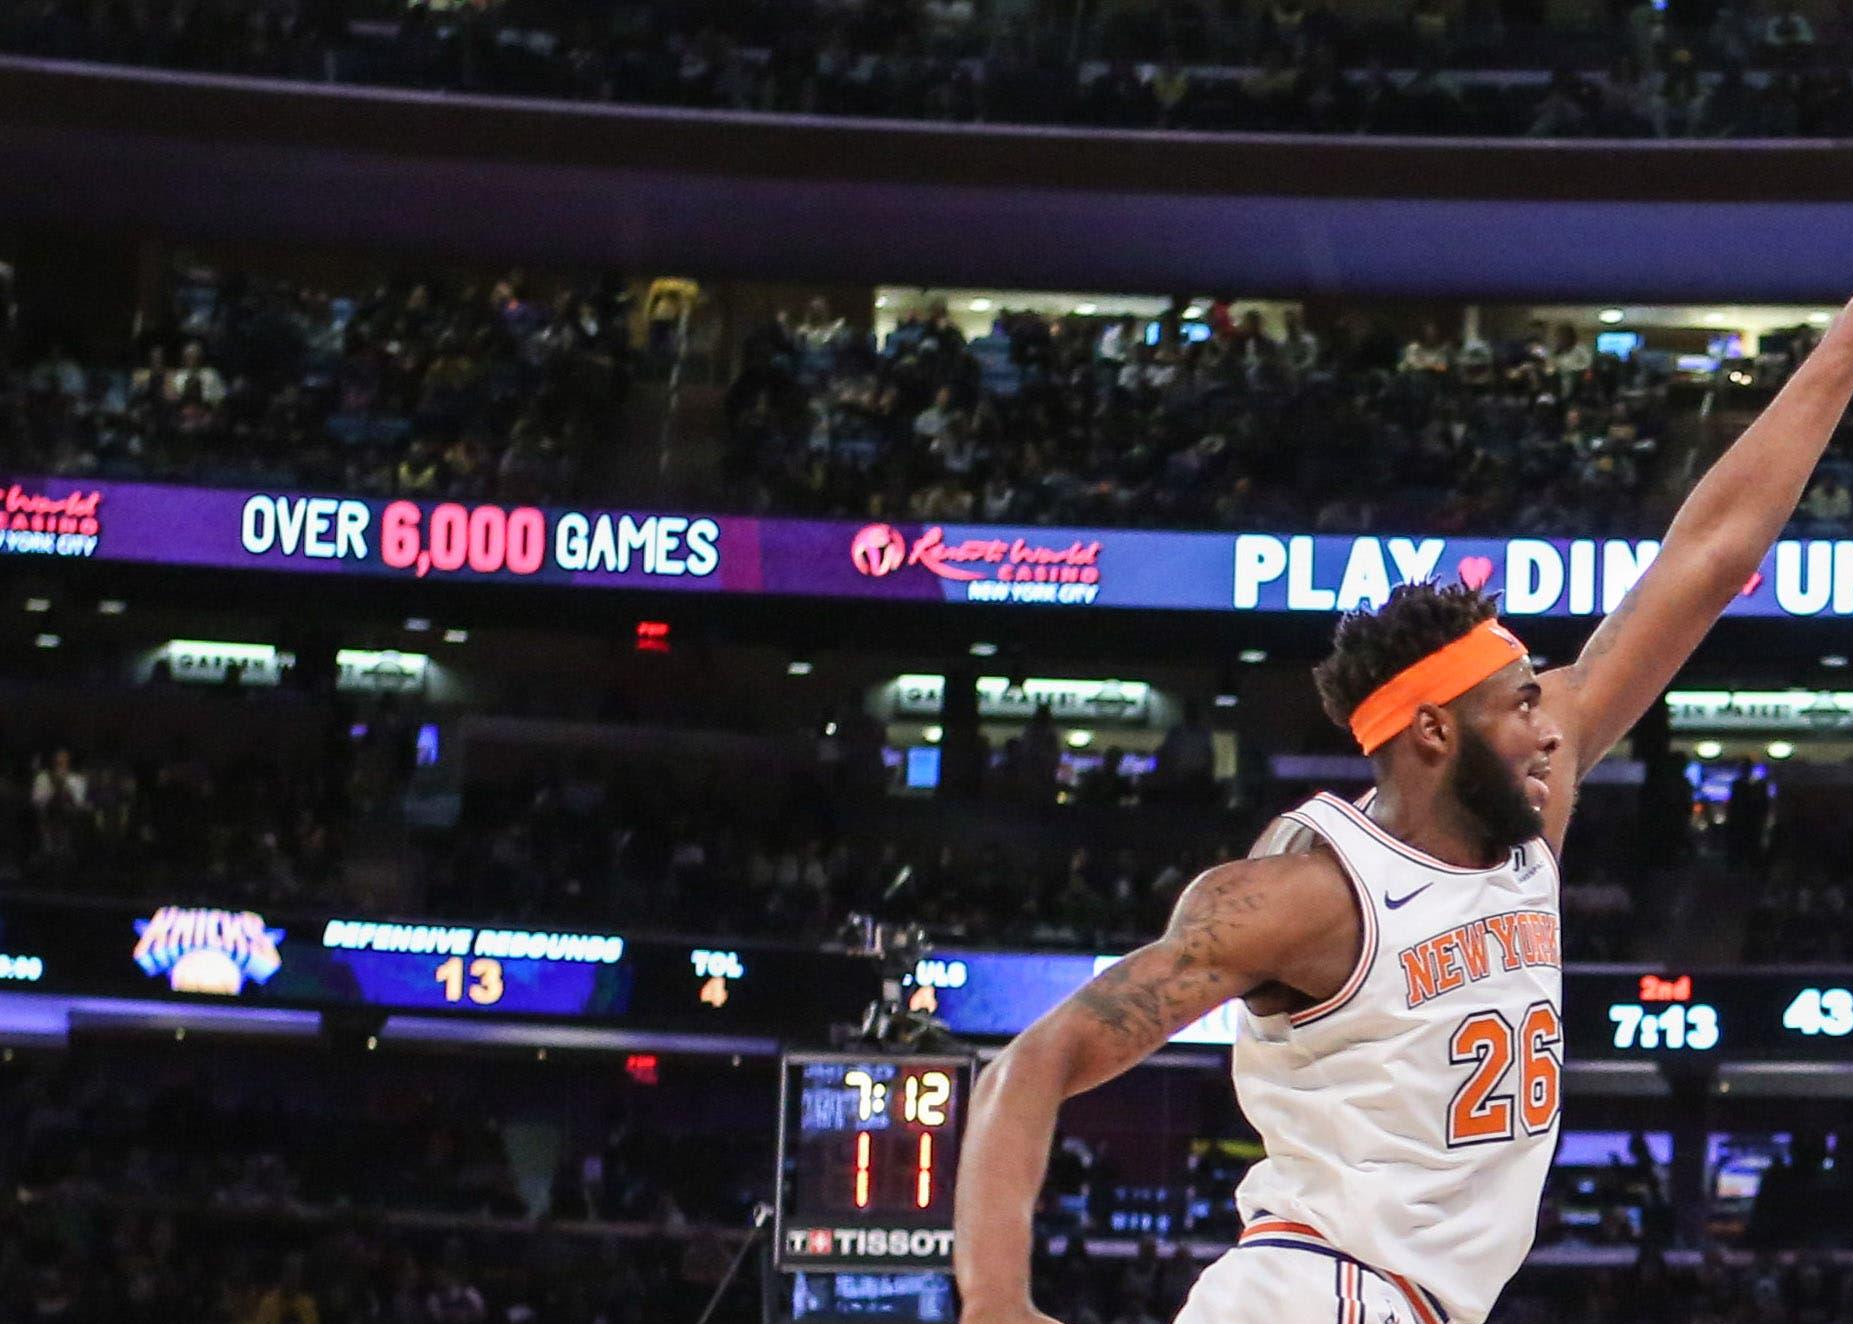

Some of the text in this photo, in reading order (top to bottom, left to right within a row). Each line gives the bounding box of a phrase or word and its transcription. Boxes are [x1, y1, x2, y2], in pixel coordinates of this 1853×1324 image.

[241, 493, 721, 578] OVER 6,000 GAMES
[997, 562, 1100, 585] CASINO
[1232, 534, 1446, 612] PLAY
[1504, 537, 1662, 615] DIN
[323, 920, 624, 964] DEFENSIVE REBOUNDS
[690, 949, 744, 979] TOL
[1399, 919, 1491, 1010] NEW
[434, 956, 505, 1005] 13
[700, 975, 729, 1009] 4
[1639, 975, 1693, 1001] 2nd
[1608, 1003, 1720, 1050] 7:13
[1782, 987, 1848, 1037] 43
[844, 1070, 951, 1126] 7:12
[1446, 1000, 1562, 1149] 26
[834, 1228, 954, 1257] TISSOT
